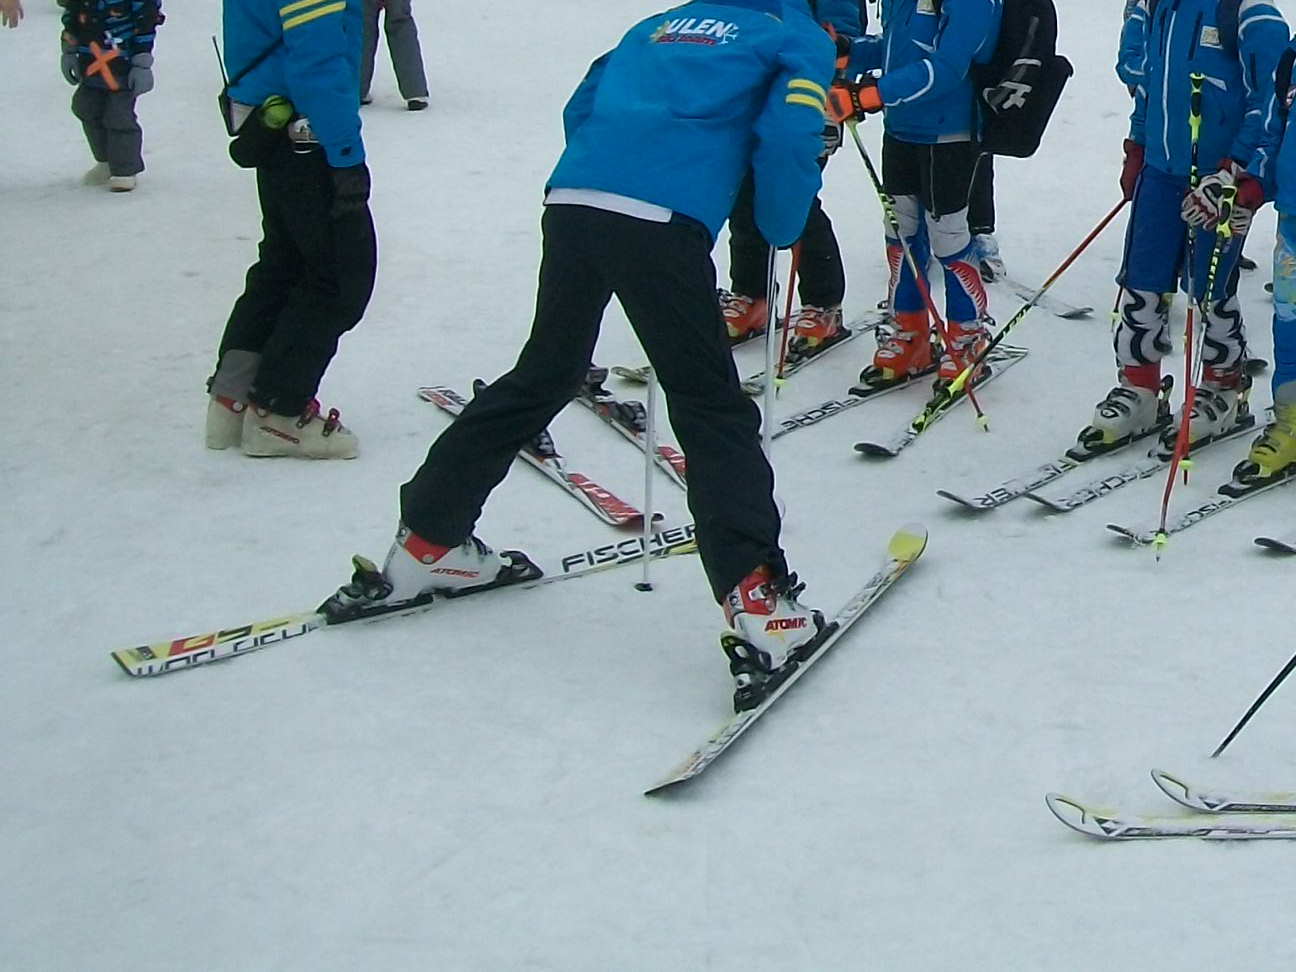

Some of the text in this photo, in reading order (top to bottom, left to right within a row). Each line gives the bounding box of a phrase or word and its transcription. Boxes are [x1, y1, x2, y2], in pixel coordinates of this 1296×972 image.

[665, 18, 734, 38] ULEN
[431, 568, 480, 578] ATOMIC
[764, 616, 808, 632] ATOMIC
